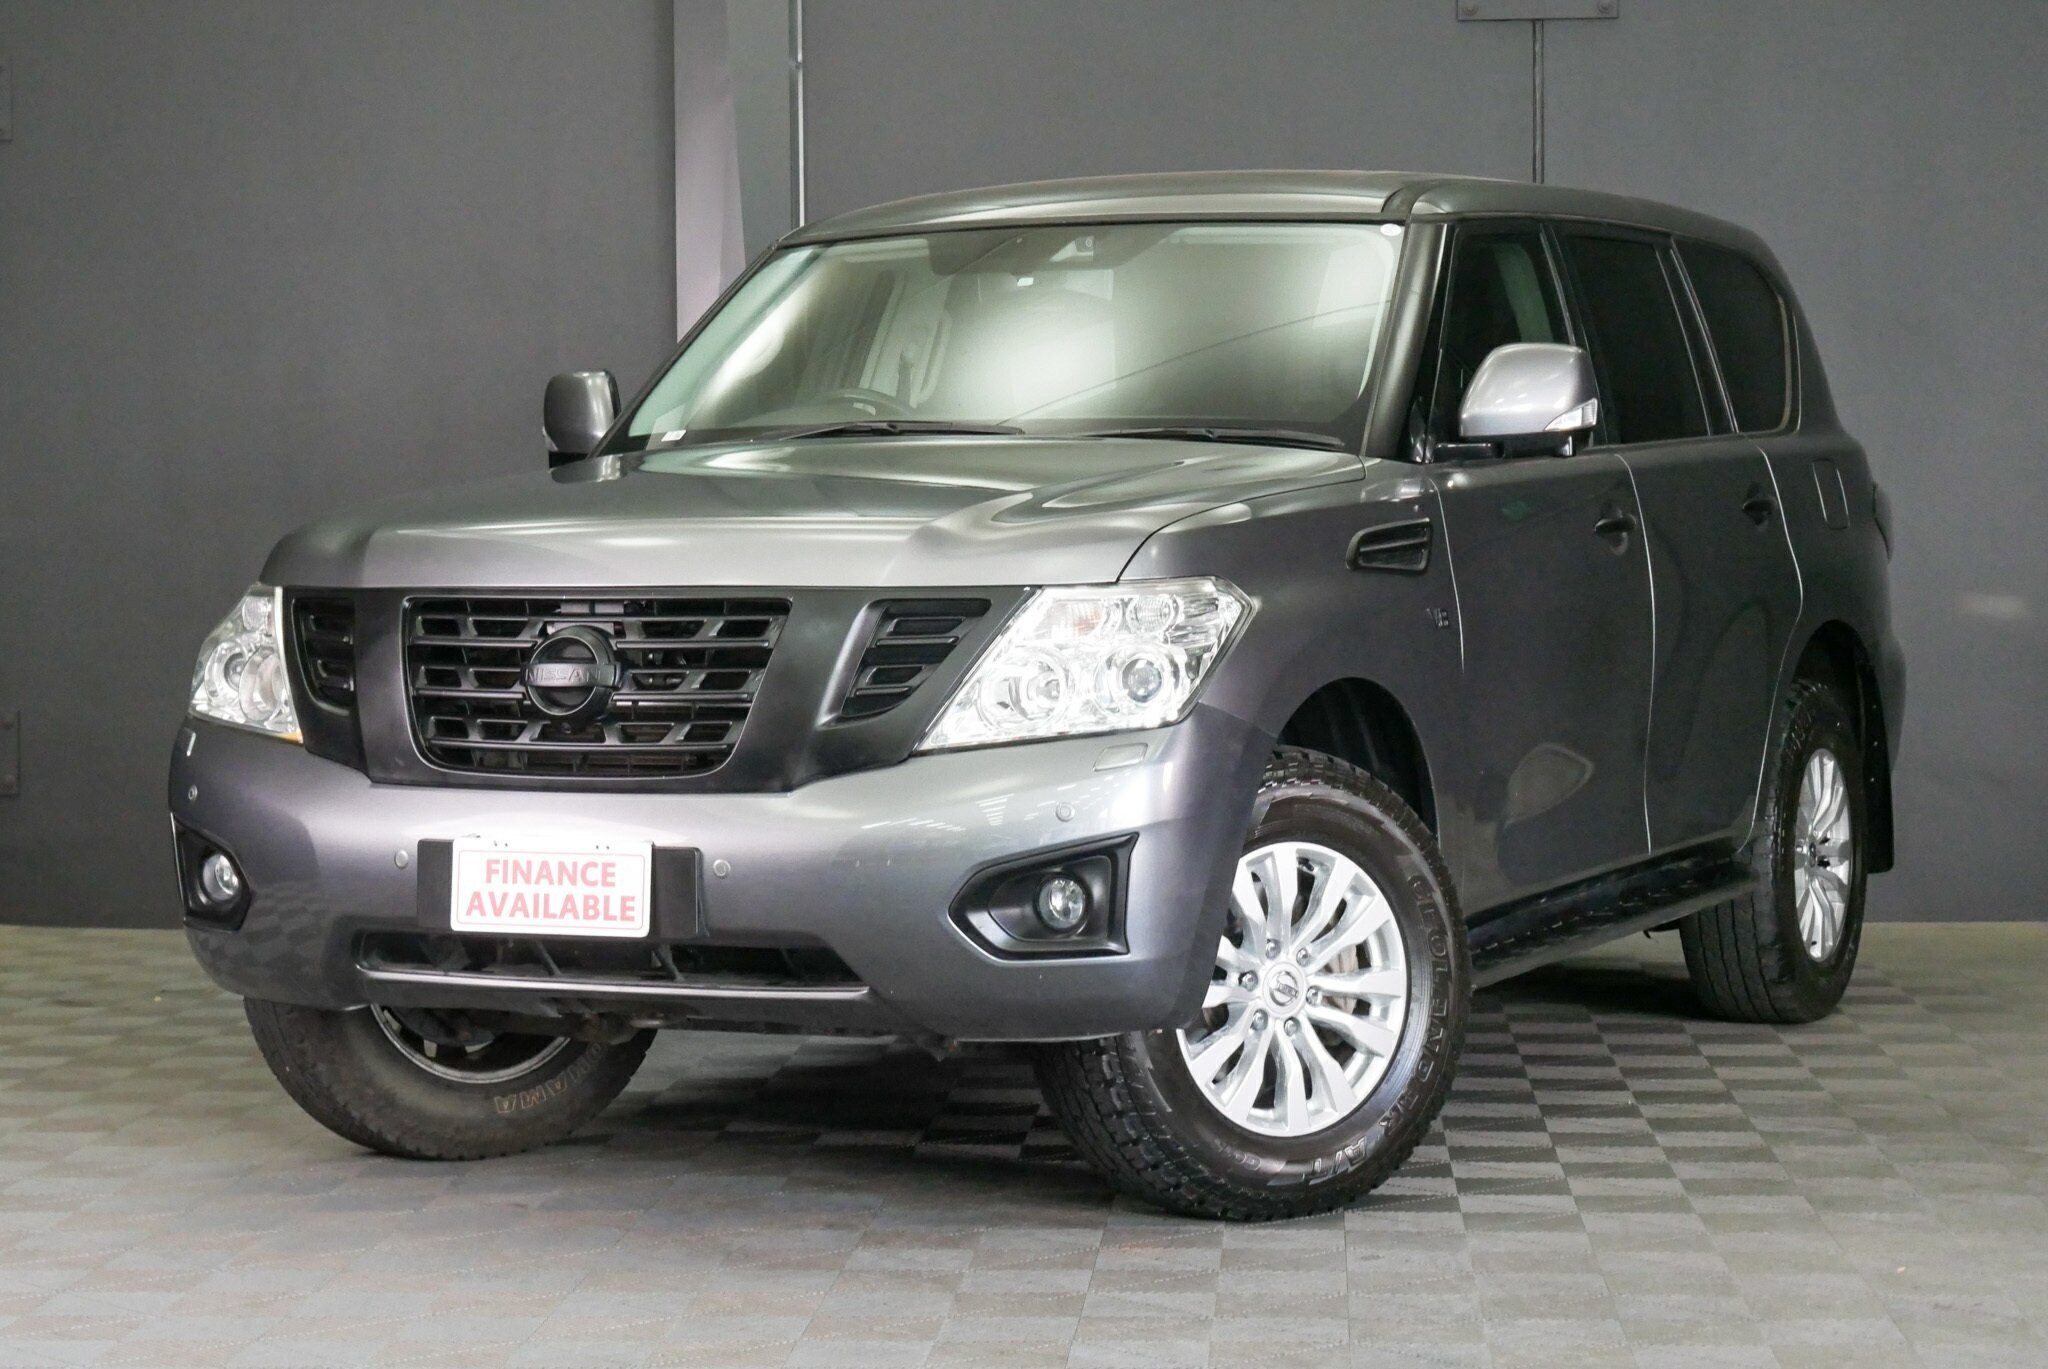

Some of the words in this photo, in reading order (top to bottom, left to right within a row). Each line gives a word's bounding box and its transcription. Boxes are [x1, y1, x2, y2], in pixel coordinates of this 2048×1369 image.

[525, 667, 601, 683] NISSAN
[485, 859, 616, 888] FINANCE
[465, 891, 636, 922] AVAILABLE
